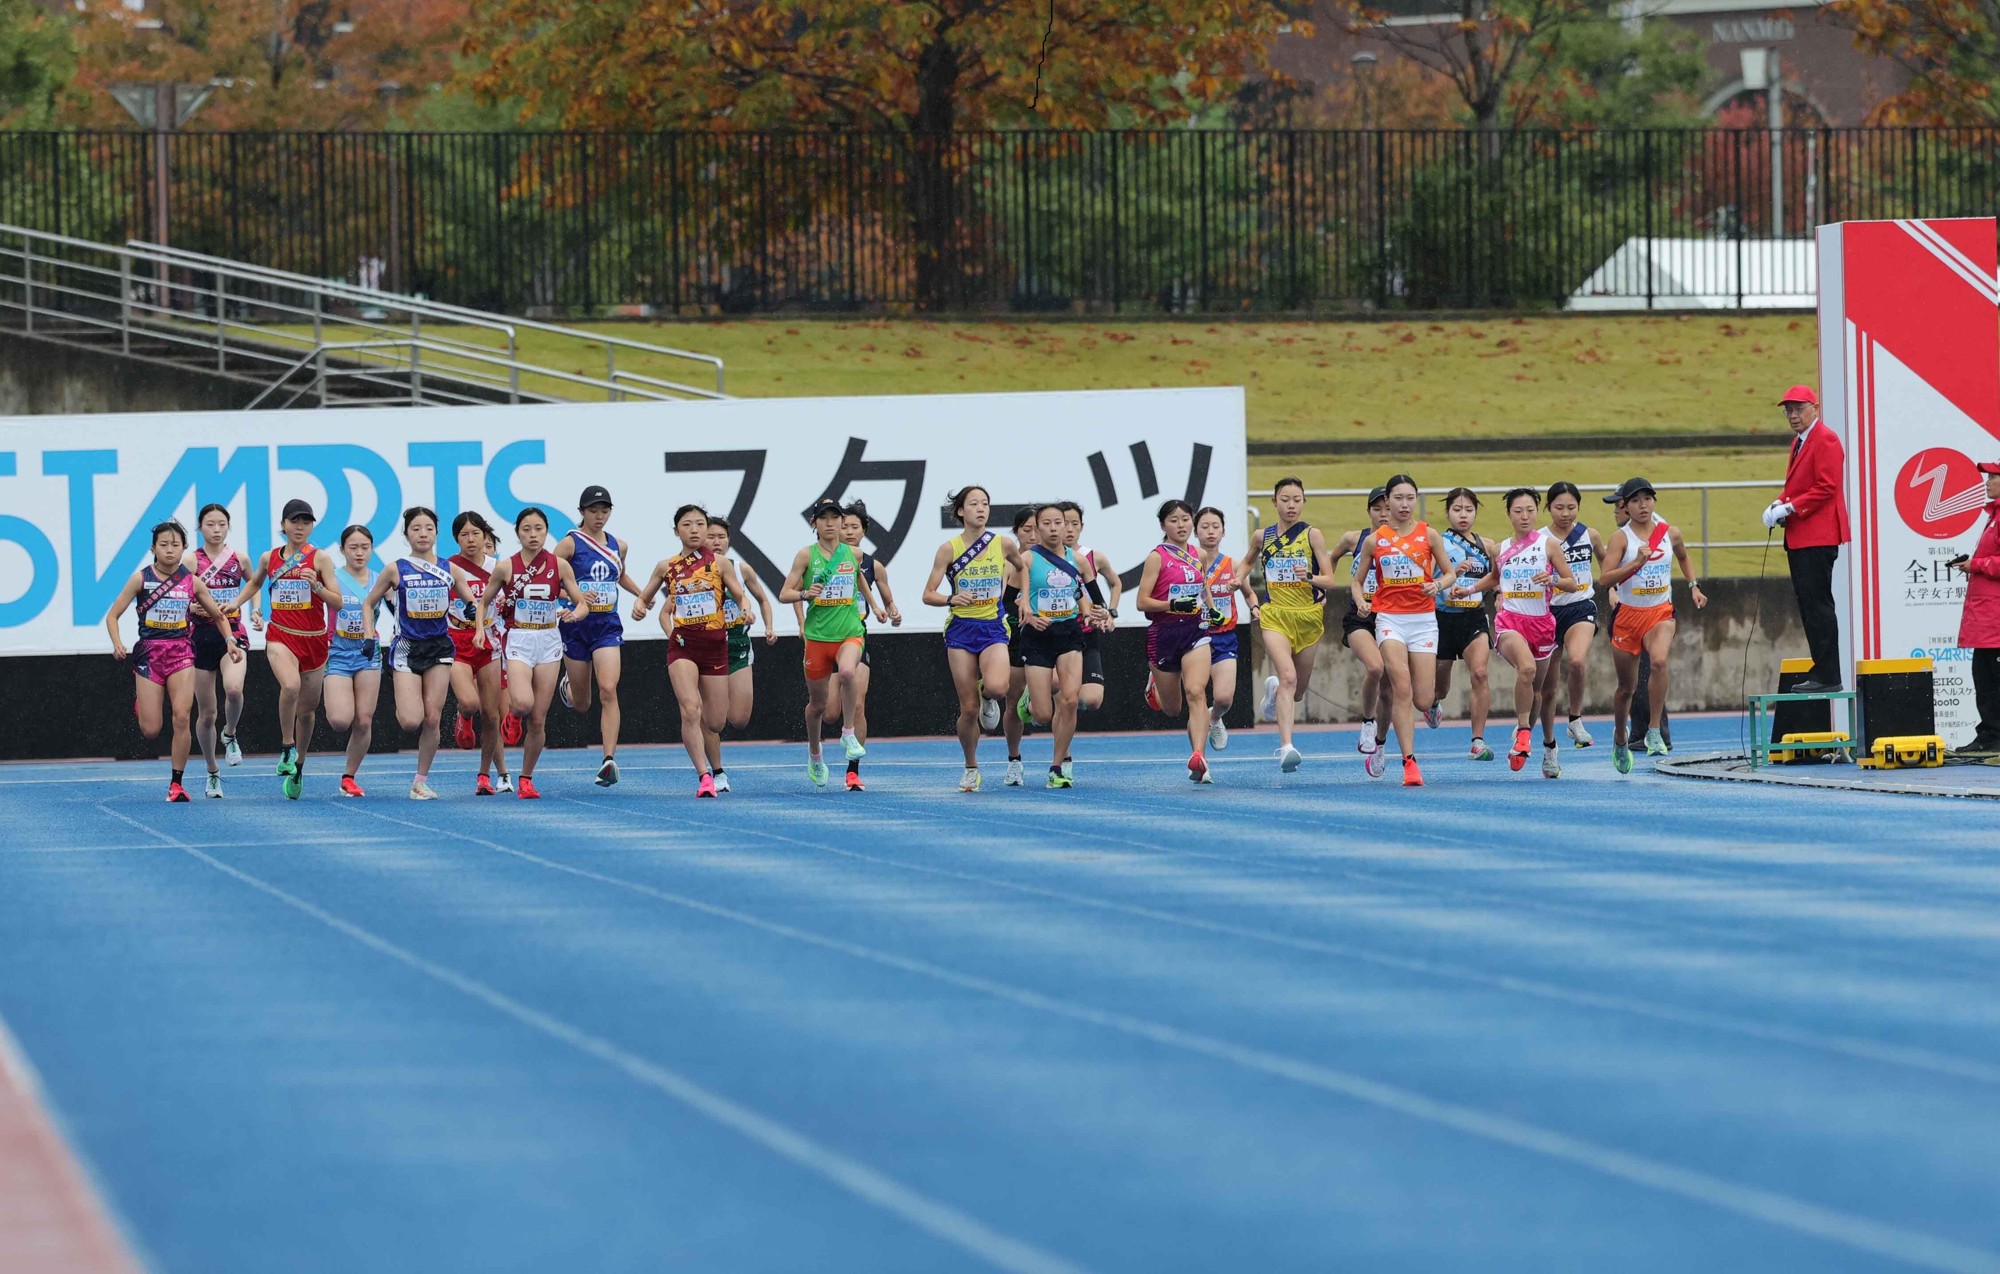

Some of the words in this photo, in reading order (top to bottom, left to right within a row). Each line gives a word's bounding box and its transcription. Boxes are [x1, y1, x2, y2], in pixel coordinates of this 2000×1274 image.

[664, 437, 1213, 601] スターツ
[1276, 549, 1305, 558] 西大学
[1928, 546, 1955, 555] 第43回
[960, 565, 1000, 576] 大阪学院
[280, 581, 310, 590] STARTS
[827, 576, 854, 586] ARTS
[970, 578, 1000, 588] STARTS
[418, 589, 448, 599] STARTS
[684, 592, 714, 605] STARTS
[826, 590, 843, 598] 2-1
[686, 608, 704, 616] 4-1
[530, 614, 544, 623] 1-1
[684, 616, 710, 624] SEIKO
[1928, 648, 1974, 662] STARTS
[1933, 678, 1963, 686] EIKO
[1934, 688, 1976, 696] 共ヘルスケ
